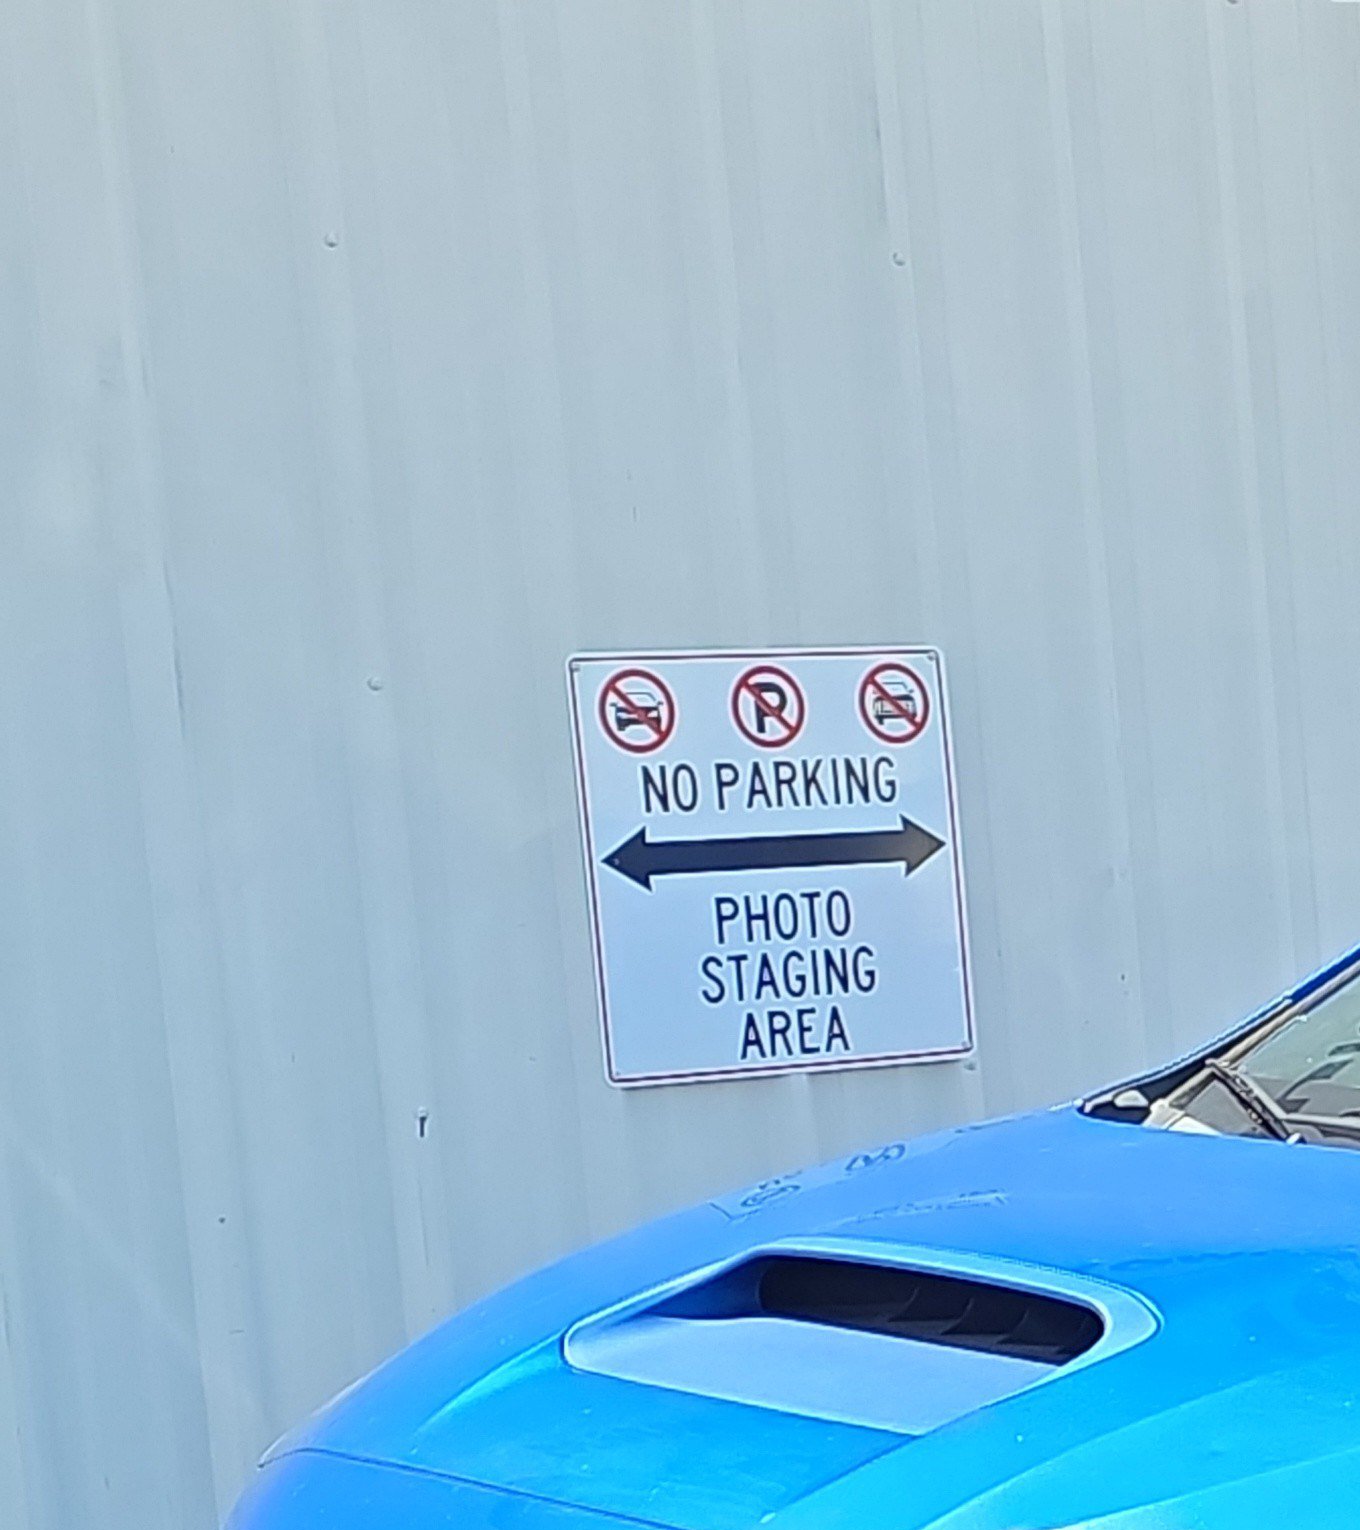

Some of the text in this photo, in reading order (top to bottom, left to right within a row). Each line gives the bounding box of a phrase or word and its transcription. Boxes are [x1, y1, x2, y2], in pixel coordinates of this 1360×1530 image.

[641, 756, 896, 813] NO PARKING
[714, 890, 851, 945] PHOTO
[701, 945, 876, 1004] STAGING
[740, 1005, 851, 1060] AREA
